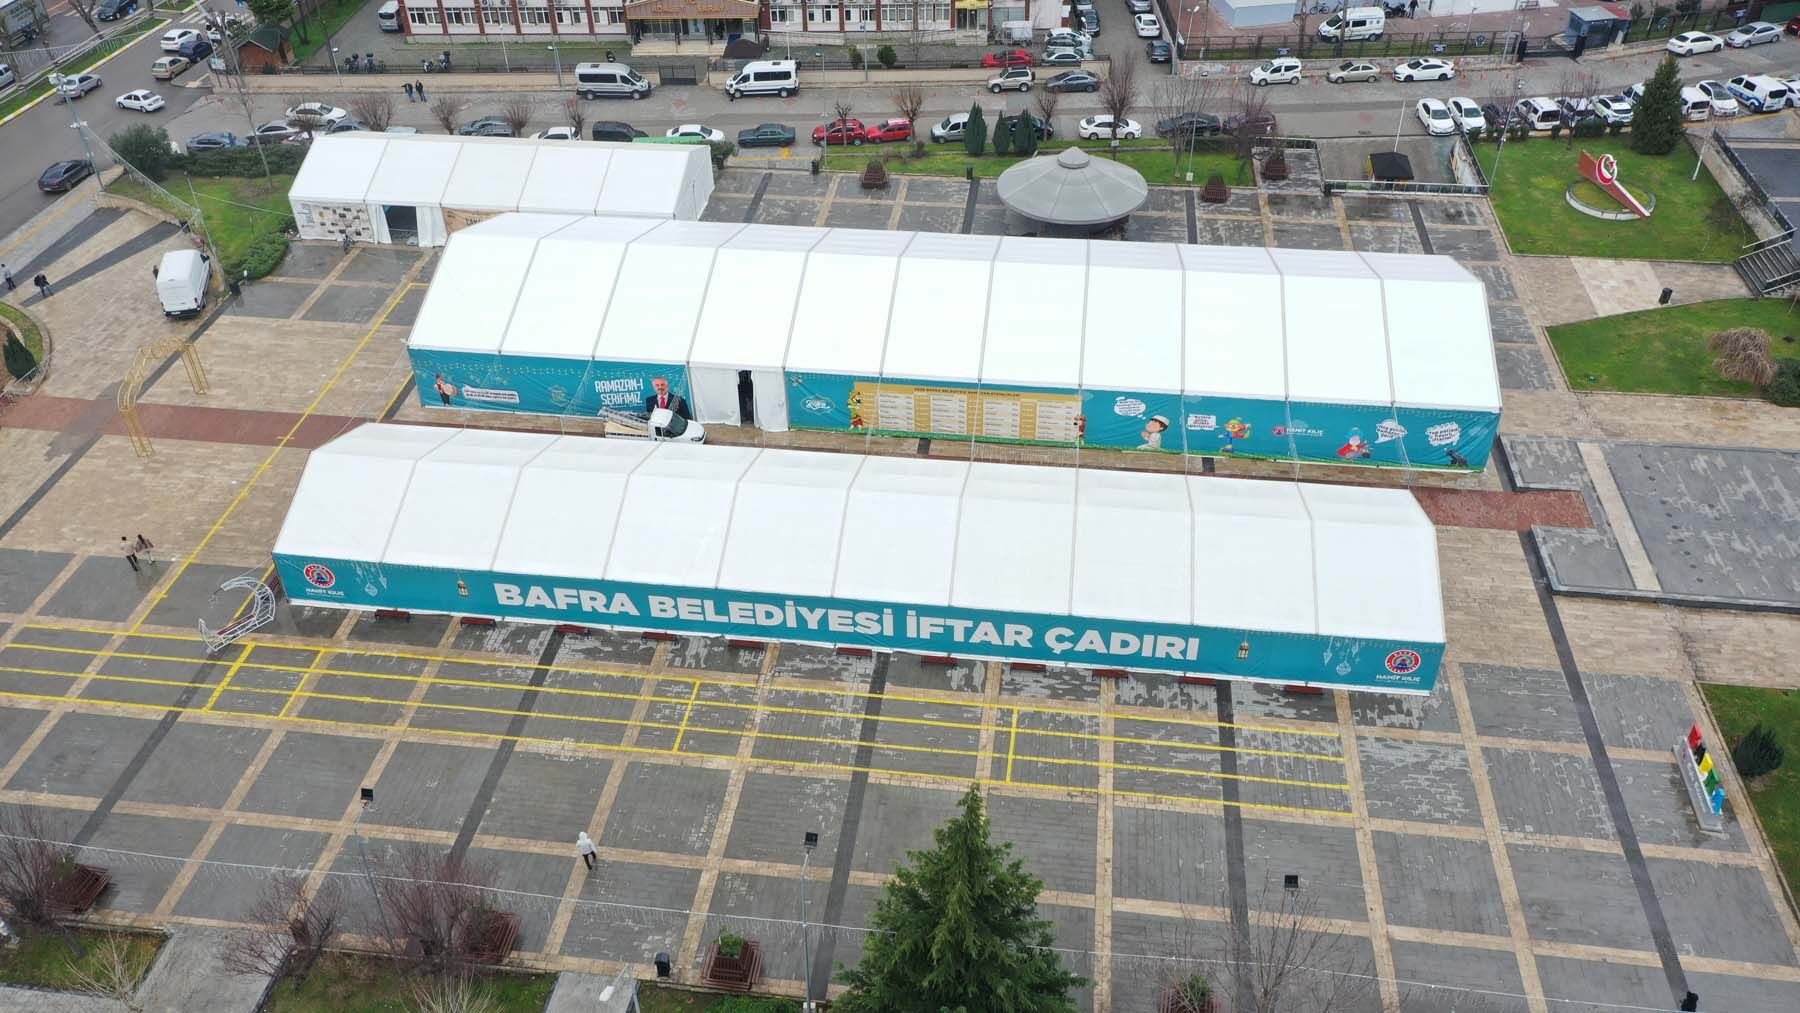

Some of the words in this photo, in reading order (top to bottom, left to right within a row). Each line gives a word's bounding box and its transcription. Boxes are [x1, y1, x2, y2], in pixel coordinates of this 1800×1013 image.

[594, 378, 644, 393] RAMAZAN-I
[494, 582, 641, 616] BAFRA
[648, 595, 894, 637] BELEDİYESİ
[906, 610, 1034, 648] İFTAR
[1044, 626, 1200, 661] ÇADIRI
